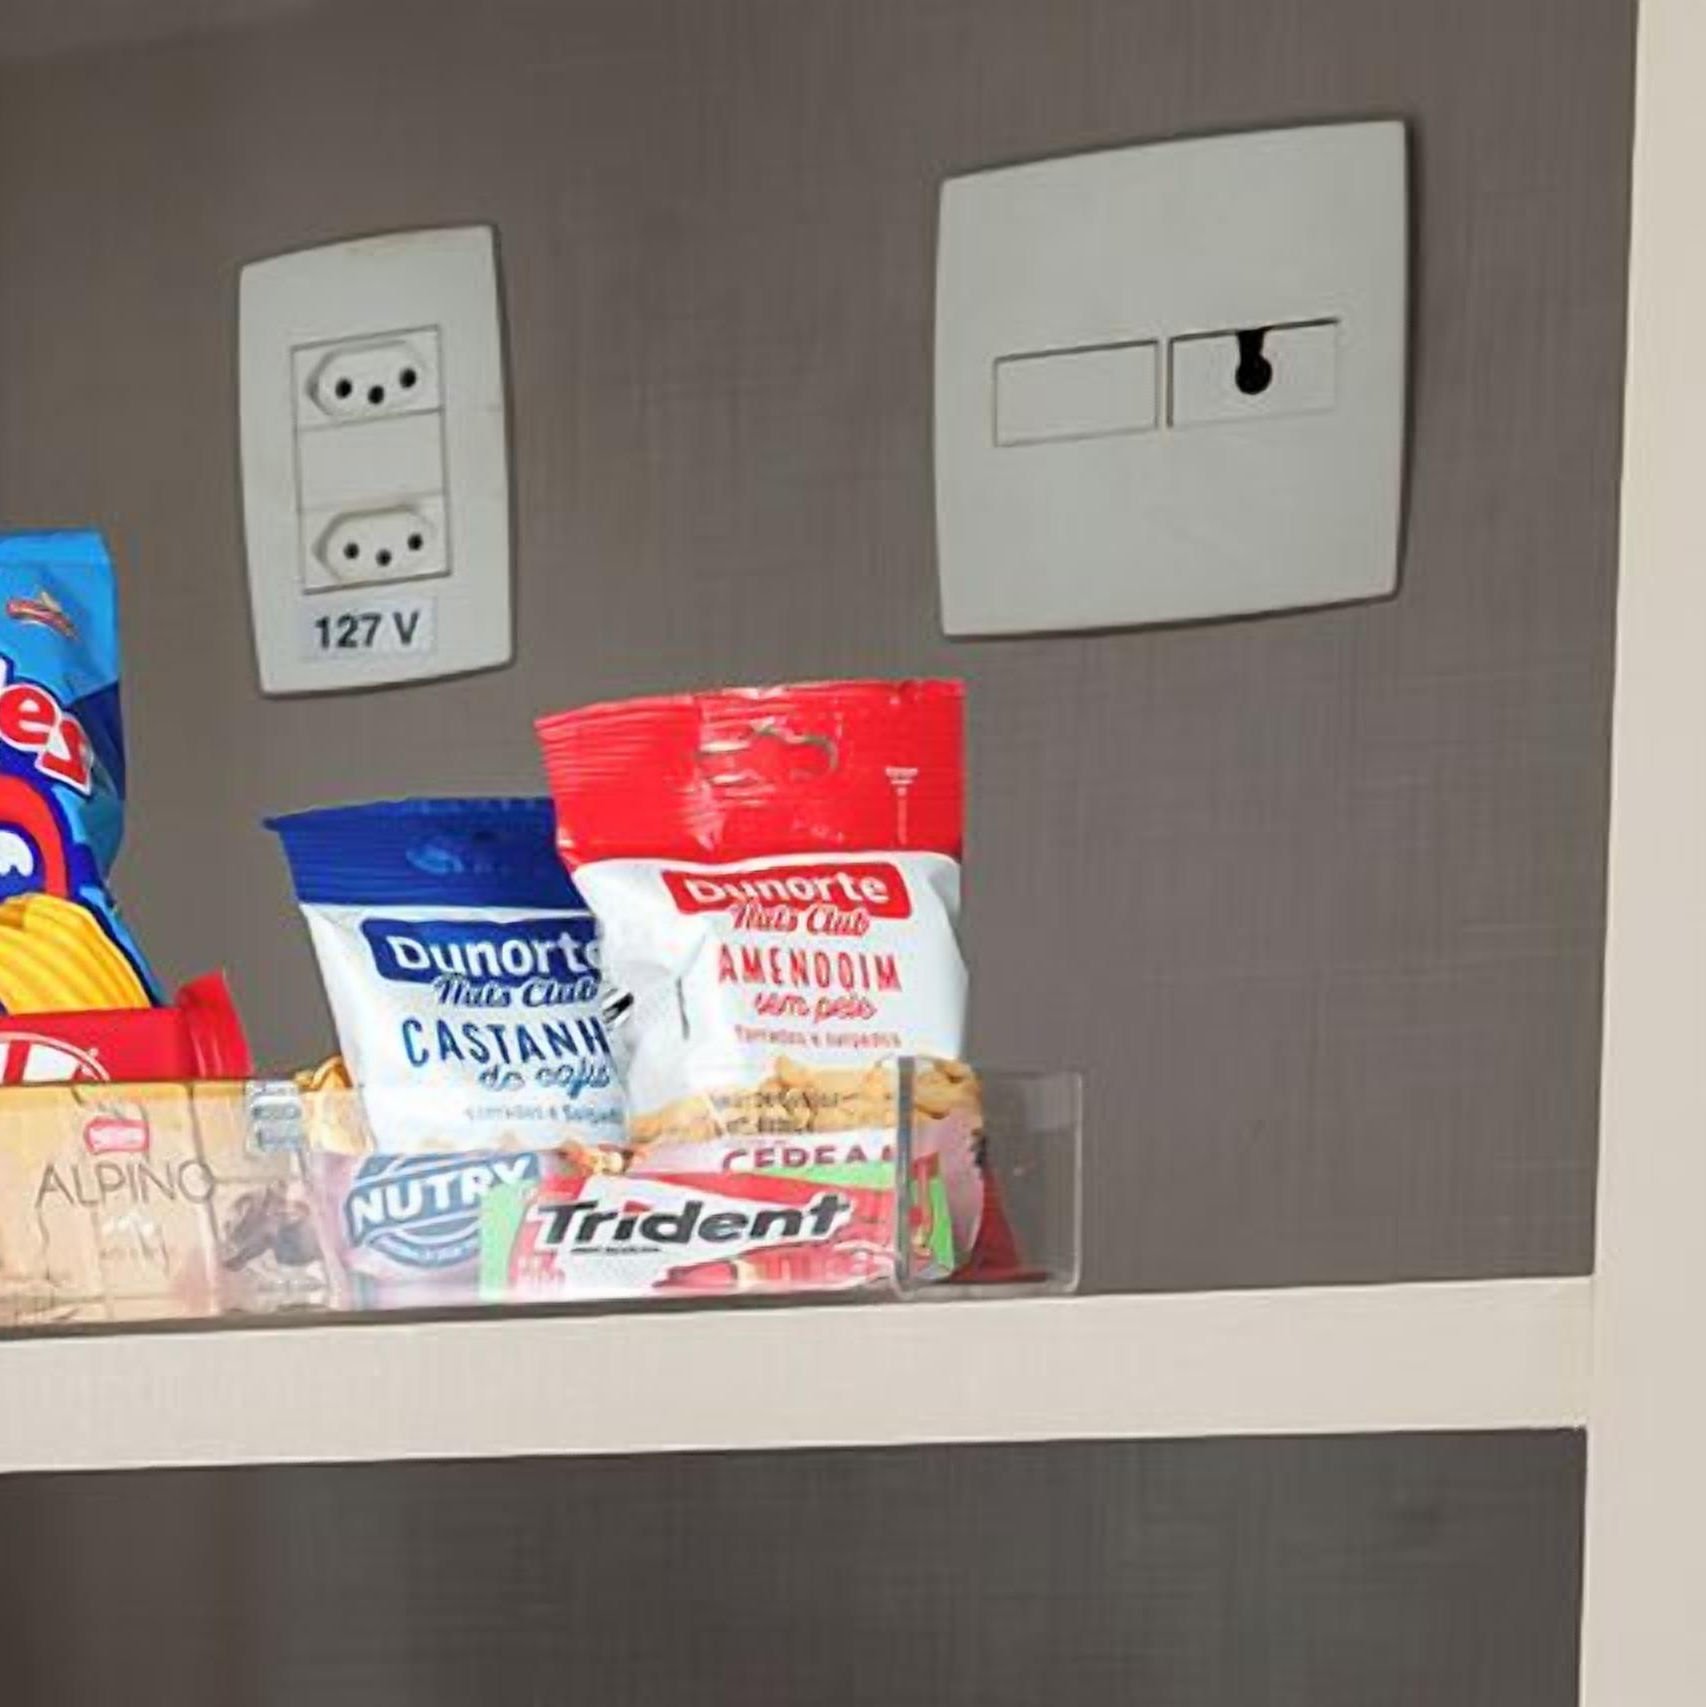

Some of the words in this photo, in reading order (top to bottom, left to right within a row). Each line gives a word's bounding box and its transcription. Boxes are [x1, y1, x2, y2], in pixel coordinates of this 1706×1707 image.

[314, 612, 382, 650] 127
[392, 611, 421, 646] V
[684, 871, 890, 904] Dunorte
[718, 943, 903, 993] AMENDOIM
[402, 1016, 611, 1068] CASTANH
[34, 1159, 217, 1209] ALPINO
[351, 1155, 534, 1236] NUTRY
[539, 1191, 854, 1247] Trident
